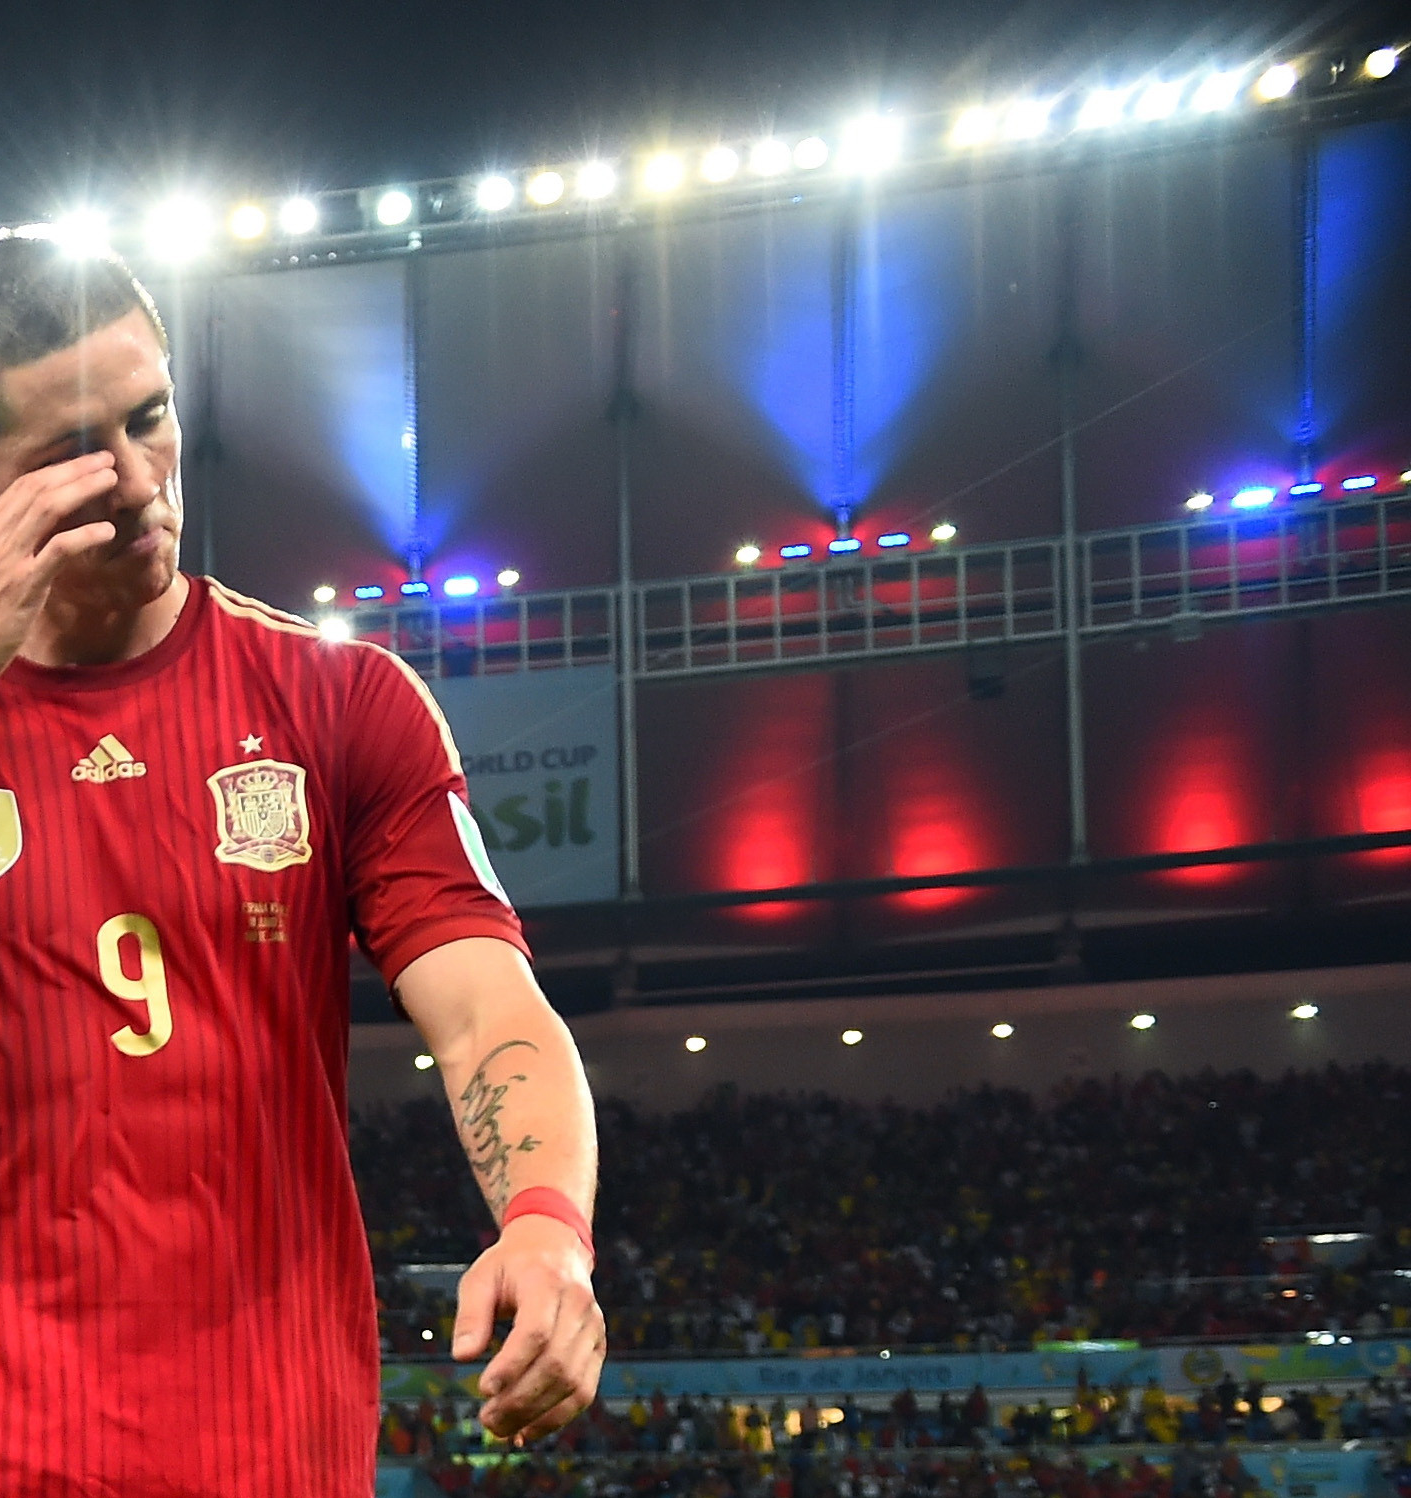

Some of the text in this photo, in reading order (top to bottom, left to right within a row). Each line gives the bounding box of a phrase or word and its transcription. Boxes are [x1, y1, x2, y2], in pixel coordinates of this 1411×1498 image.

[541, 745, 597, 770] CUP
[71, 761, 147, 784] adidas
[96, 913, 173, 1057] 9
